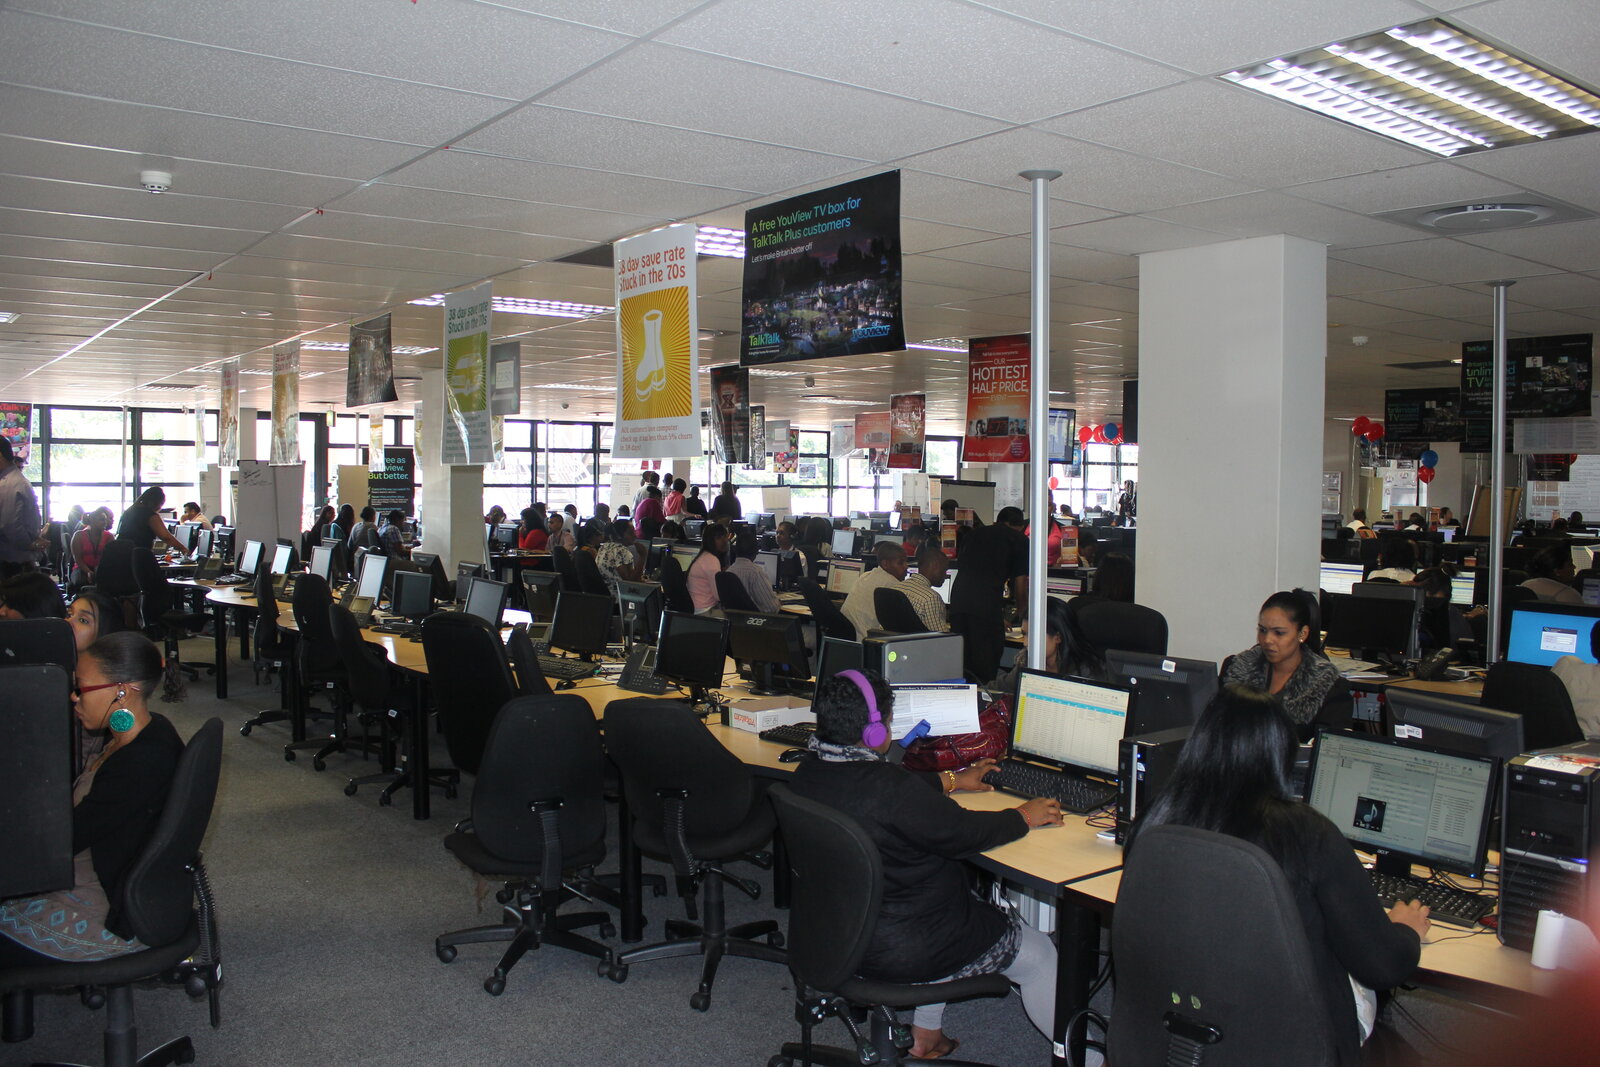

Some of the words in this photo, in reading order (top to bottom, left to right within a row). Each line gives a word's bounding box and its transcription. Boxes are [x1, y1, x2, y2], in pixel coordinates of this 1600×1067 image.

[752, 222, 758, 234] A
[759, 219, 776, 232] free
[777, 209, 812, 228] YouView
[814, 204, 827, 218] TV
[828, 201, 845, 215] box
[847, 197, 861, 210] for
[752, 231, 783, 249] TalkTalk
[785, 227, 801, 242] Plus
[803, 217, 851, 237] customers
[626, 256, 640, 272] day
[642, 252, 661, 268] save
[664, 246, 686, 263] rate
[763, 251, 776, 261] make
[776, 248, 791, 258] Britain
[639, 271, 646, 286] in
[649, 267, 663, 284] the
[667, 264, 686, 280] 70s
[749, 332, 780, 346] TalkTalk
[972, 364, 1028, 381] HOTTEST
[972, 382, 998, 394] HALF
[999, 380, 1028, 393] PRICE
[1466, 377, 1484, 388] TV
[368, 472, 382, 480] But
[384, 472, 408, 480] better.
[746, 617, 767, 626] acer
